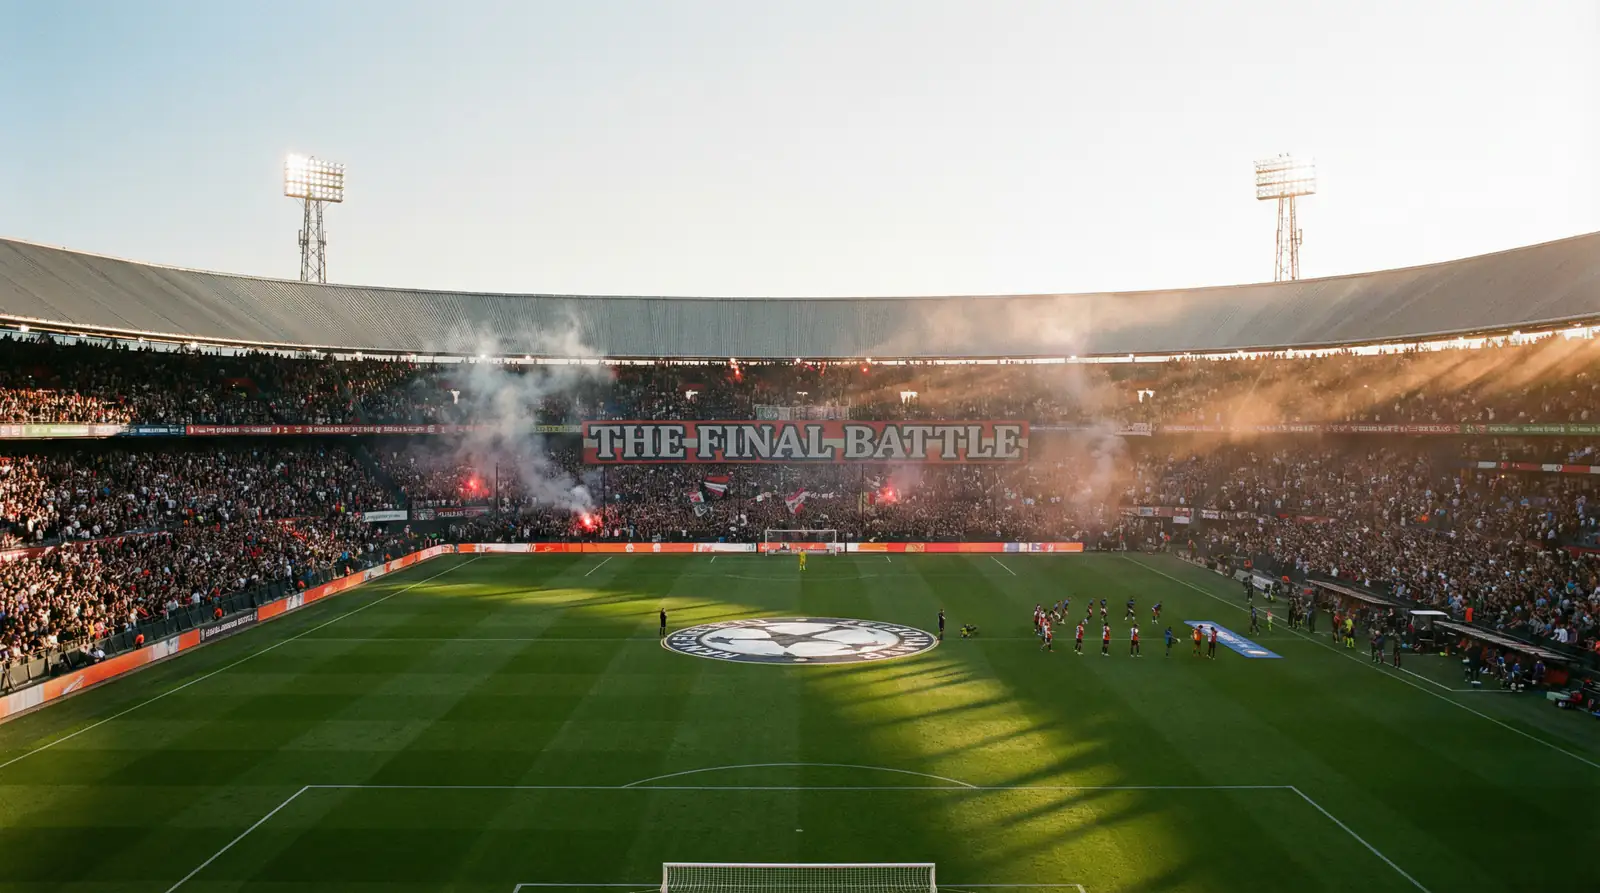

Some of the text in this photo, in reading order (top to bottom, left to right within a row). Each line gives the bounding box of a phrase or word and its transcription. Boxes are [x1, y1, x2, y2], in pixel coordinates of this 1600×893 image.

[589, 424, 1022, 459] THE FINAL BATTLE
